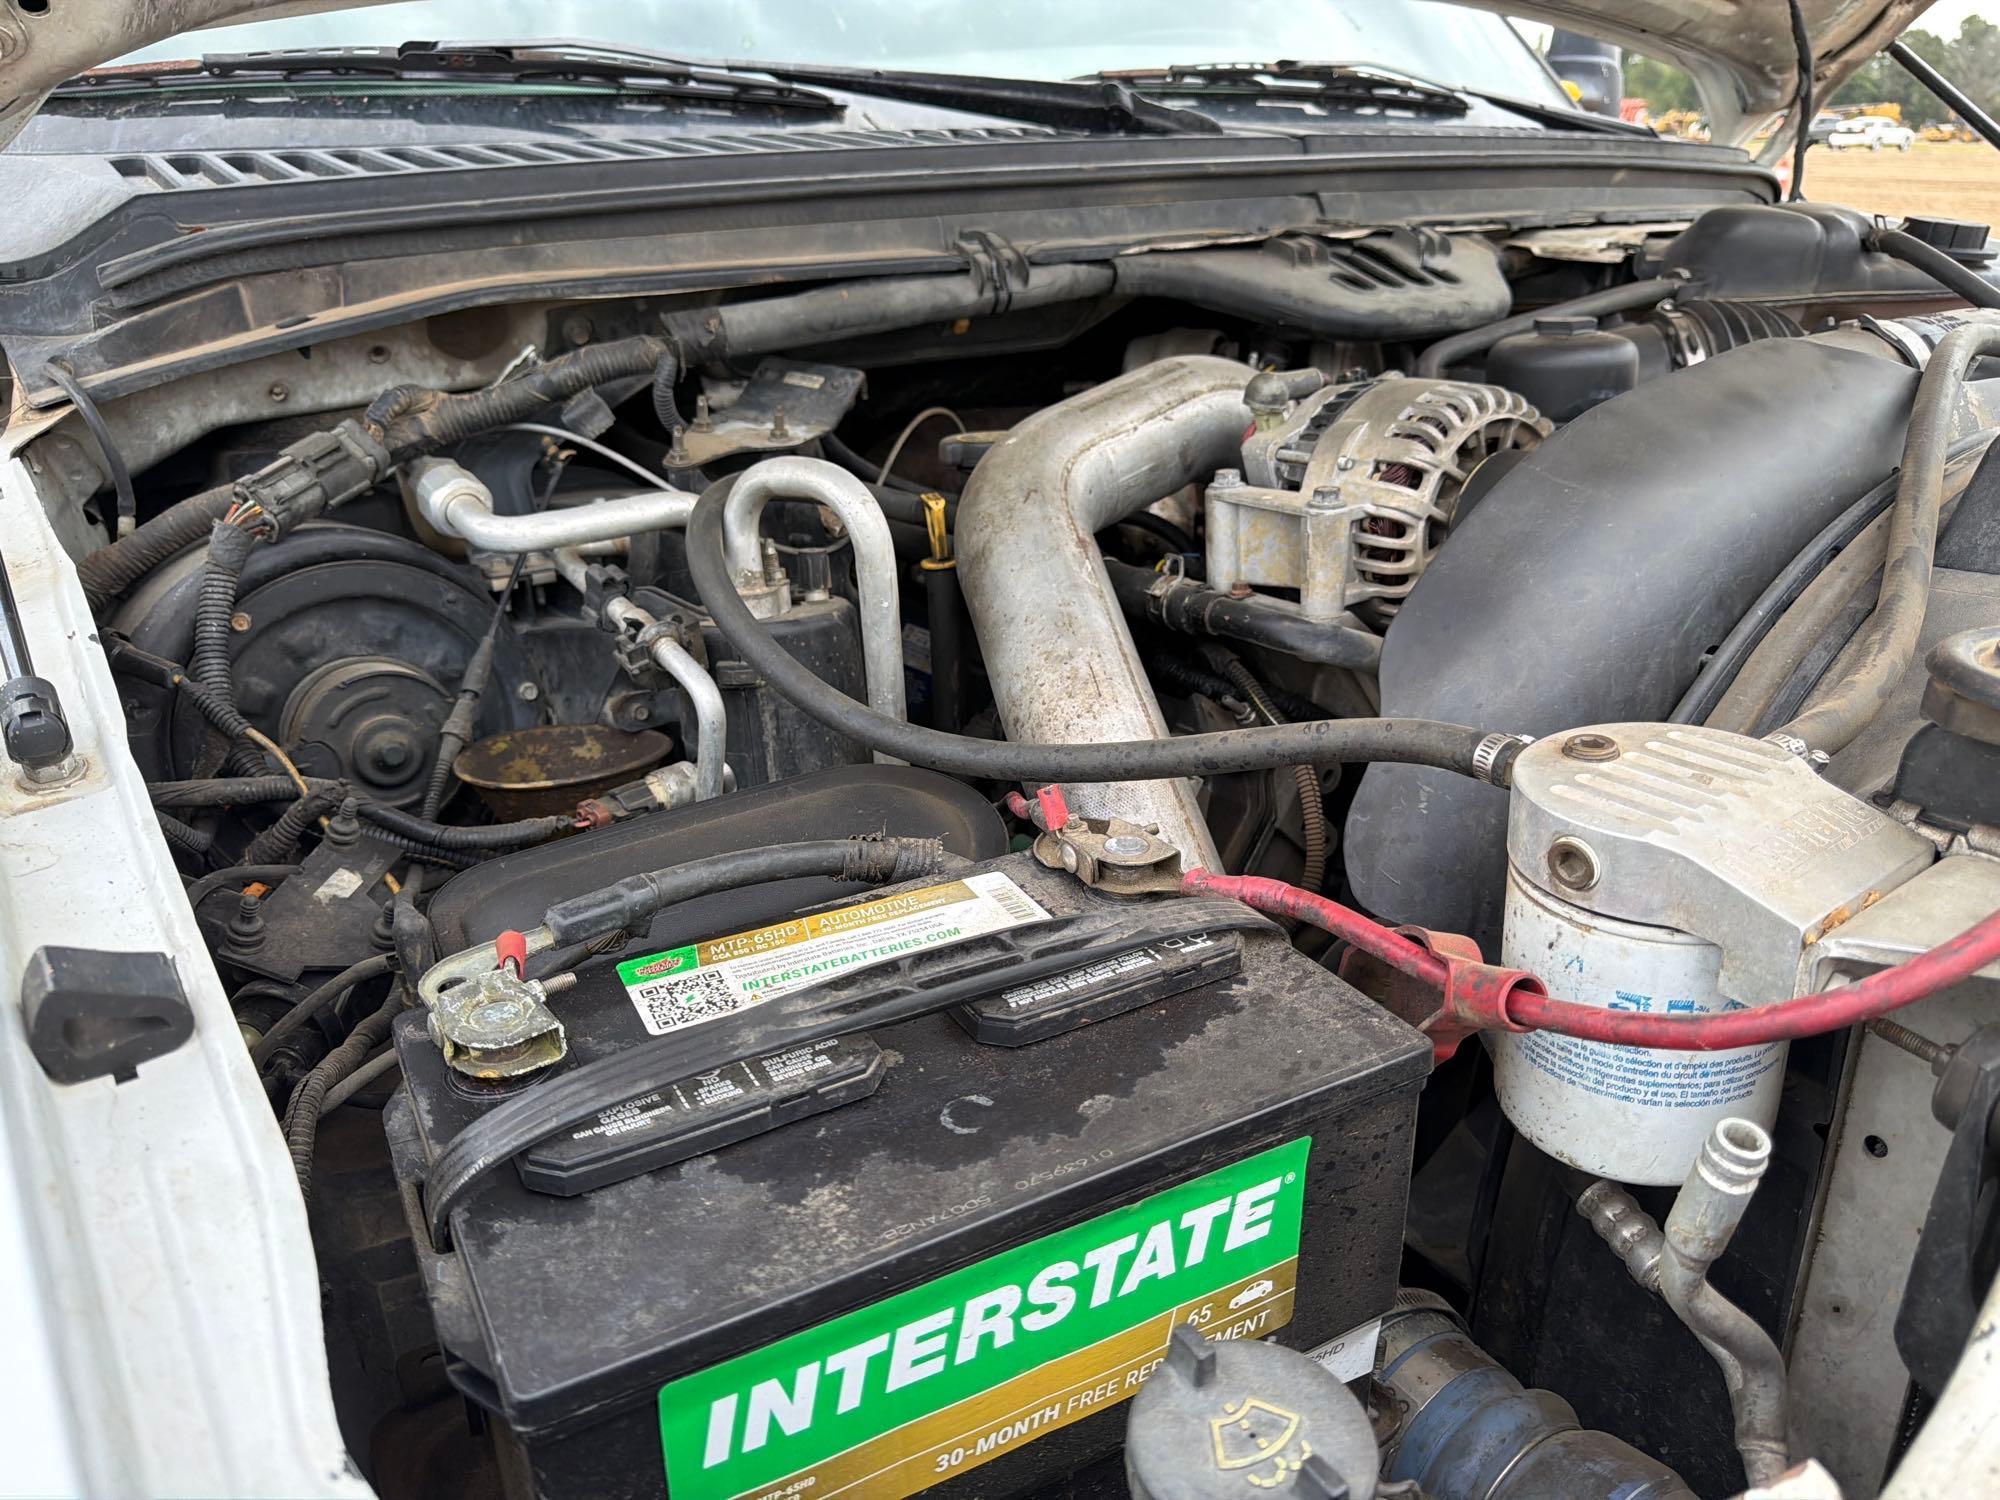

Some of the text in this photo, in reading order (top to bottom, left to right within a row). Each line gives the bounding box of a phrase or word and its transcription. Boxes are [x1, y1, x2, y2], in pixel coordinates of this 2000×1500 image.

[820, 895, 919, 928] AUTOMOTIVE
[821, 897, 946, 933] 30-MONTH FREE REPLACEMENT
[710, 926, 797, 955] MTP-65HD
[712, 951, 731, 961] CCA
[756, 943, 769, 951] RC
[742, 926, 961, 991] INTERSTATEBATTERIES.COM
[761, 1039, 838, 1067] SULFURIC ACID
[765, 1054, 813, 1072] CAN CAUSE
[1612, 1052, 1624, 1063] de
[1625, 1055, 1663, 1069] sélection
[1664, 1060, 1673, 1070] et
[1709, 1059, 1723, 1069] des
[769, 1054, 828, 1077] BLINDNESS OR
[772, 1059, 832, 1082] SEVERE BURNS
[1582, 1053, 1590, 1062] le
[1591, 1057, 1614, 1070] mode
[1660, 1069, 1672, 1079] du
[1673, 1069, 1698, 1080] circuit
[1700, 1069, 1710, 1079] de
[698, 1079, 732, 1094] SPARKS
[701, 1084, 735, 1099] FLAMES
[702, 1076, 719, 1086] NO
[1566, 1076, 1577, 1087] de
[1636, 1095, 1663, 1108] varían
[1664, 1098, 1672, 1108] la
[1673, 1097, 1711, 1109] selección
[1711, 1095, 1724, 1106] del
[1592, 1076, 1605, 1088] del
[1605, 1082, 1642, 1097] producto
[1643, 1089, 1650, 1098] y
[1650, 1088, 1659, 1098] el
[1660, 1089, 1678, 1099] uso.
[1680, 1089, 1689, 1099] El
[1719, 1085, 1731, 1096] del
[1702, 1081, 1721, 1091] para
[597, 1094, 661, 1118] EXPLOSIVE
[599, 1107, 641, 1124] GASES
[572, 1105, 673, 1140] CAN CAUSE BLINDNESS
[604, 1118, 651, 1137] OR INJURY
[1187, 1303, 1214, 1327] 65
[934, 1403, 1061, 1473] 30-MONTH
[1066, 1376, 1121, 1415] FREE
